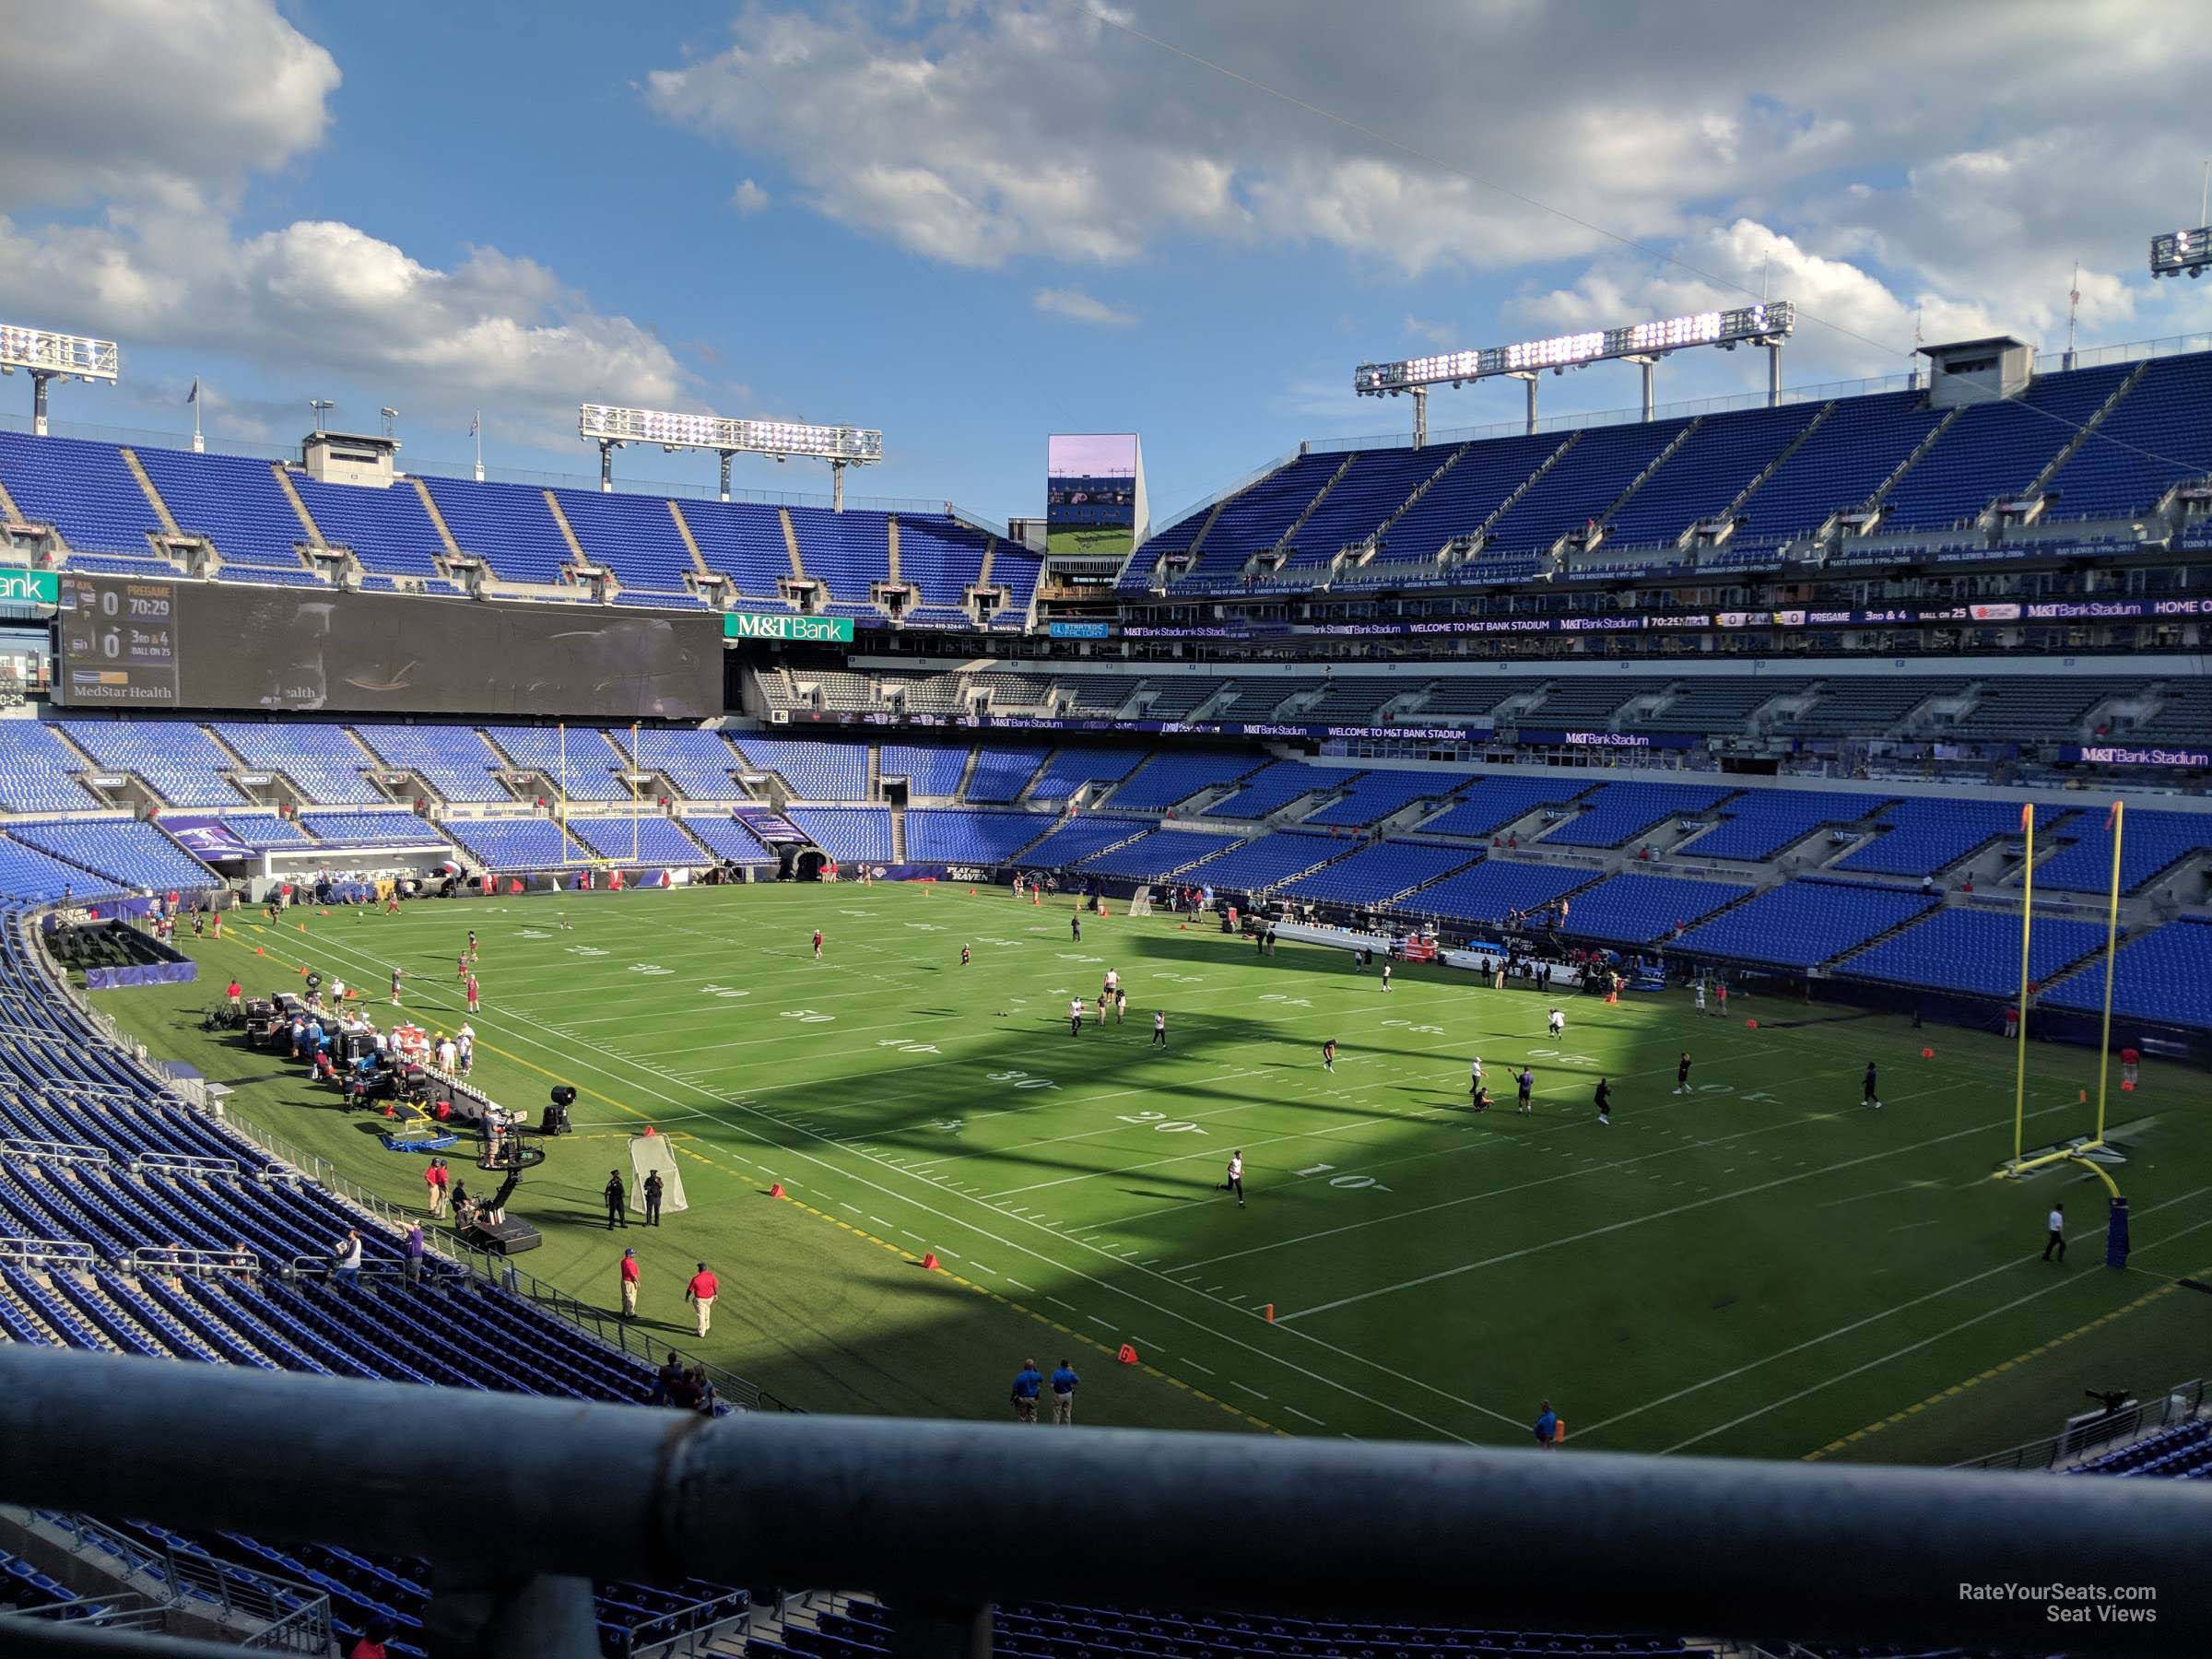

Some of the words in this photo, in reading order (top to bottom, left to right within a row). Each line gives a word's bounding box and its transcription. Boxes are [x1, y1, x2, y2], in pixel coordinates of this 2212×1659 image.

[0, 573, 42, 598] ank
[126, 584, 171, 597] PREGAME
[103, 592, 119, 616] 0
[129, 599, 170, 615] 70:29
[2028, 605, 2060, 617] M&T
[2061, 604, 2089, 616] Bank
[2090, 602, 2141, 615] Stadium
[2156, 601, 2198, 613] HOME
[1729, 615, 1737, 624] 0
[1791, 614, 1798, 623] 0
[1810, 611, 1850, 622] PREGAME
[1865, 611, 1883, 620] 3RD
[1886, 611, 1896, 619] &
[1899, 610, 1907, 619] 4
[1952, 608, 1966, 618] 25
[737, 615, 792, 638] M&T
[793, 618, 841, 640] Bank
[1354, 625, 1371, 633] Bank
[1371, 624, 1401, 634] Stadium
[1409, 623, 1452, 632] WELCOME
[1453, 623, 1465, 631] TO
[1466, 622, 1486, 630] M&T
[1487, 621, 1510, 630] BANK
[1511, 620, 1549, 630] STADIUM
[1560, 619, 1582, 629] M&T
[1583, 619, 1604, 629] Bank
[1604, 618, 1638, 628] Stadium
[132, 630, 149, 643] 3RD
[159, 631, 169, 646] 4
[1124, 628, 1142, 636] M&T
[104, 634, 120, 658] 0
[132, 647, 148, 656] BALL
[149, 648, 160, 656] ON
[161, 648, 171, 656] 25
[74, 685, 127, 697] MedStar
[130, 687, 172, 698] Health
[0, 694, 24, 705] 0:29
[990, 718, 1011, 727] M&T
[1011, 719, 1030, 727] Bank
[1030, 719, 1063, 728] Stadium
[1244, 725, 1261, 734] M&T
[1261, 726, 1278, 735] Bank
[1278, 726, 1307, 735] Stadium
[1327, 726, 1369, 736] WELCOME
[1371, 728, 1382, 736] TO
[1383, 728, 1401, 737] M&T
[1403, 729, 1427, 737] BANK
[1428, 729, 1465, 739] STADIUM
[1566, 733, 1588, 744] M&T
[1588, 734, 1611, 744] Bank
[1612, 735, 1649, 746] Stadium
[2081, 747, 2116, 761] M&T
[2117, 748, 2150, 762] Bank
[2151, 750, 2208, 765] Stadium
[952, 873, 988, 881] RAVEN
[698, 983, 750, 997] 40
[780, 1009, 835, 1023] 50
[876, 1038, 938, 1053] 40
[985, 1070, 1054, 1089] 30
[1115, 1111, 1199, 1133] 20
[1291, 1163, 1376, 1189] 10
